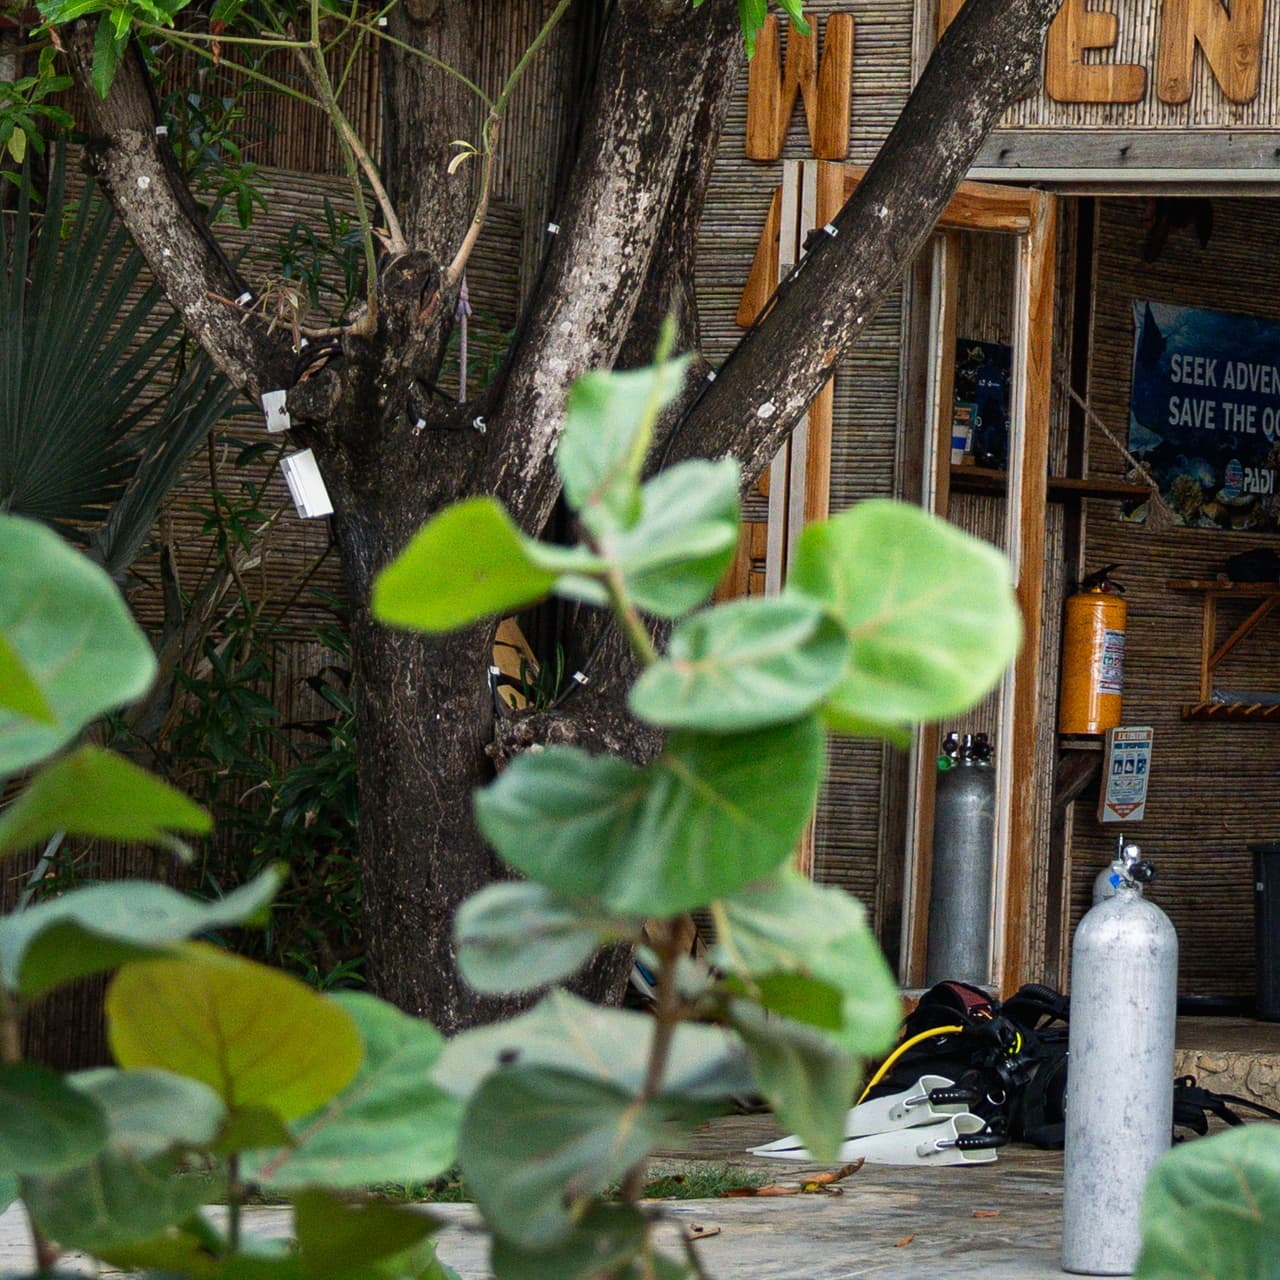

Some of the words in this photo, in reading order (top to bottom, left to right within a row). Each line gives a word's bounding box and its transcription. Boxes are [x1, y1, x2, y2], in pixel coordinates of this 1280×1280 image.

[1170, 353, 1218, 389] SEEK
[1168, 395, 1216, 430] SAVE
[1222, 402, 1257, 434] THE
[1243, 467, 1274, 495] PADI
